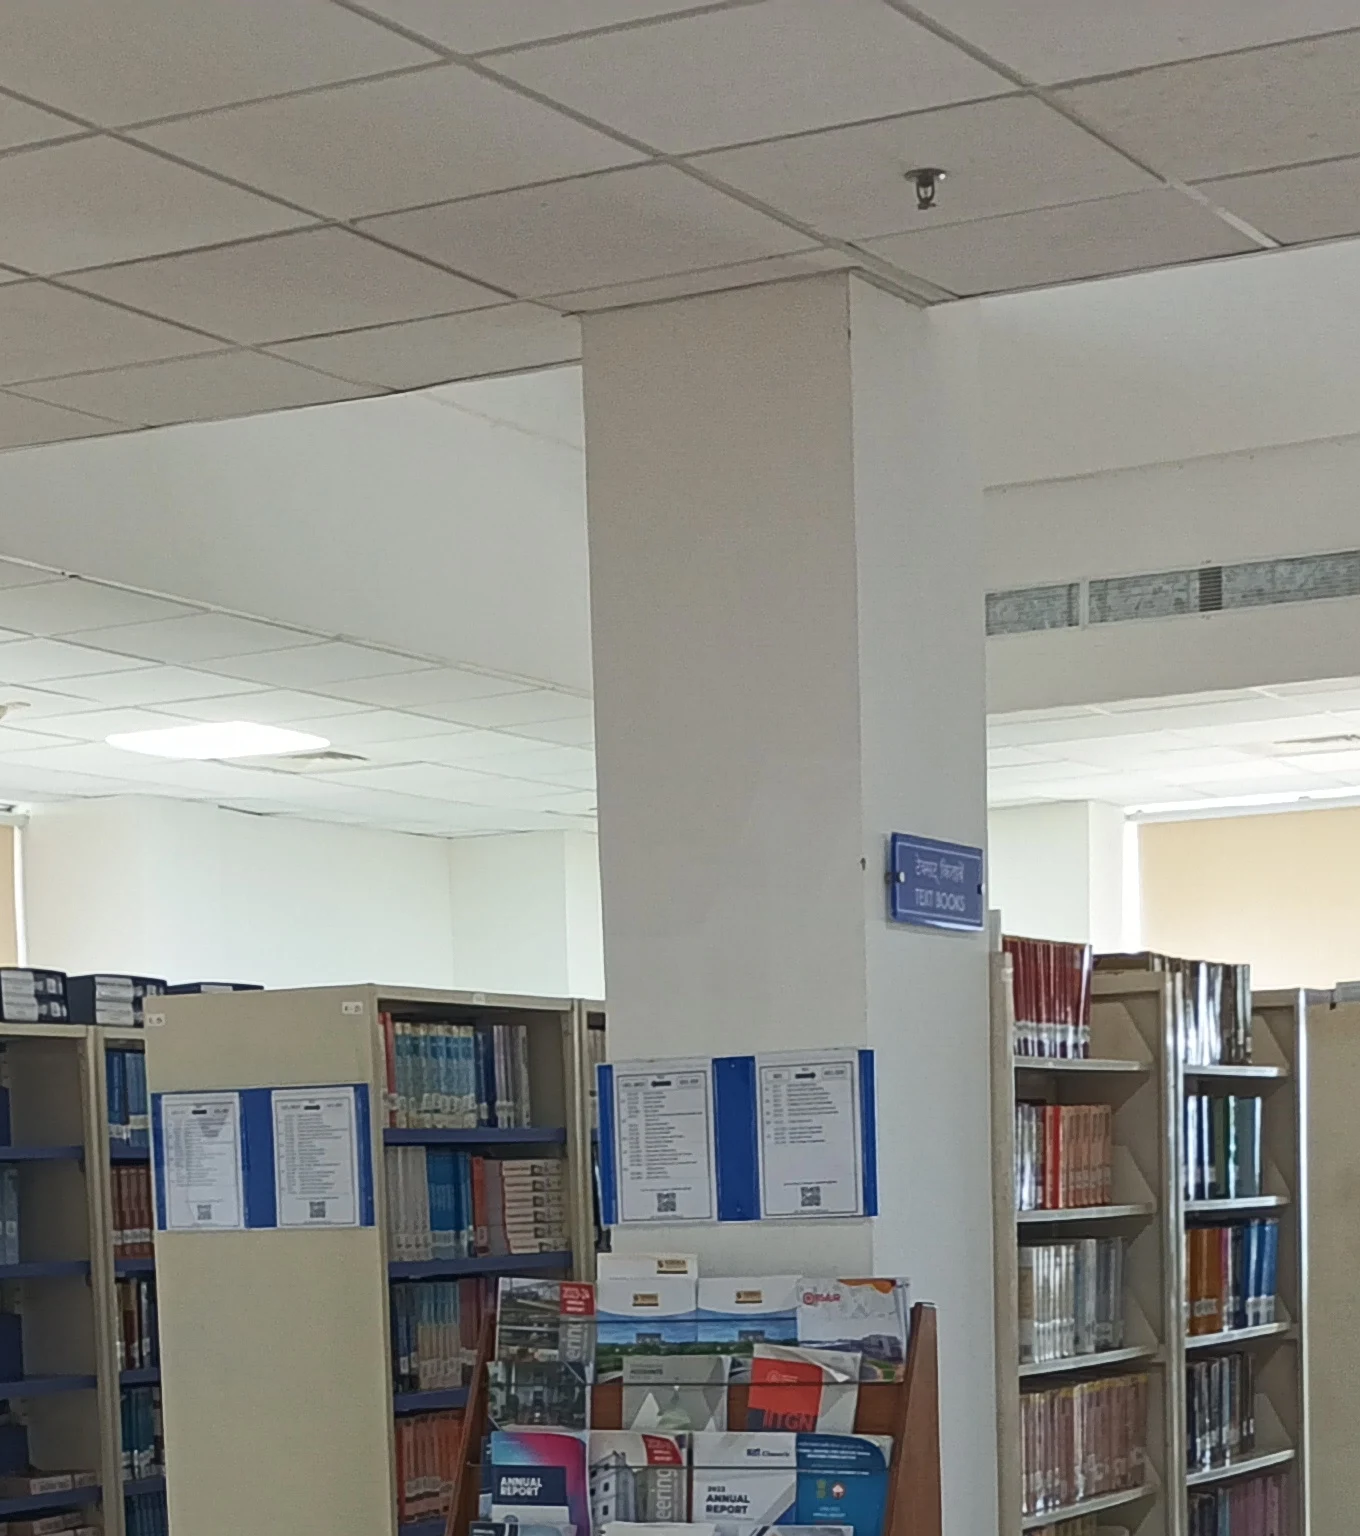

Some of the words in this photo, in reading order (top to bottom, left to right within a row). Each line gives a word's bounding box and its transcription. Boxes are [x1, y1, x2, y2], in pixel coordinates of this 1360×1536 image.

[915, 888, 934, 907] TEXT
[935, 891, 966, 912] BOOKS
[762, 1409, 815, 1431] IITGN
[500, 1476, 543, 1487] ANNUAL
[500, 1486, 540, 1496] REPORT
[706, 1494, 751, 1503] ANNUAL
[706, 1504, 749, 1514] REPORT
